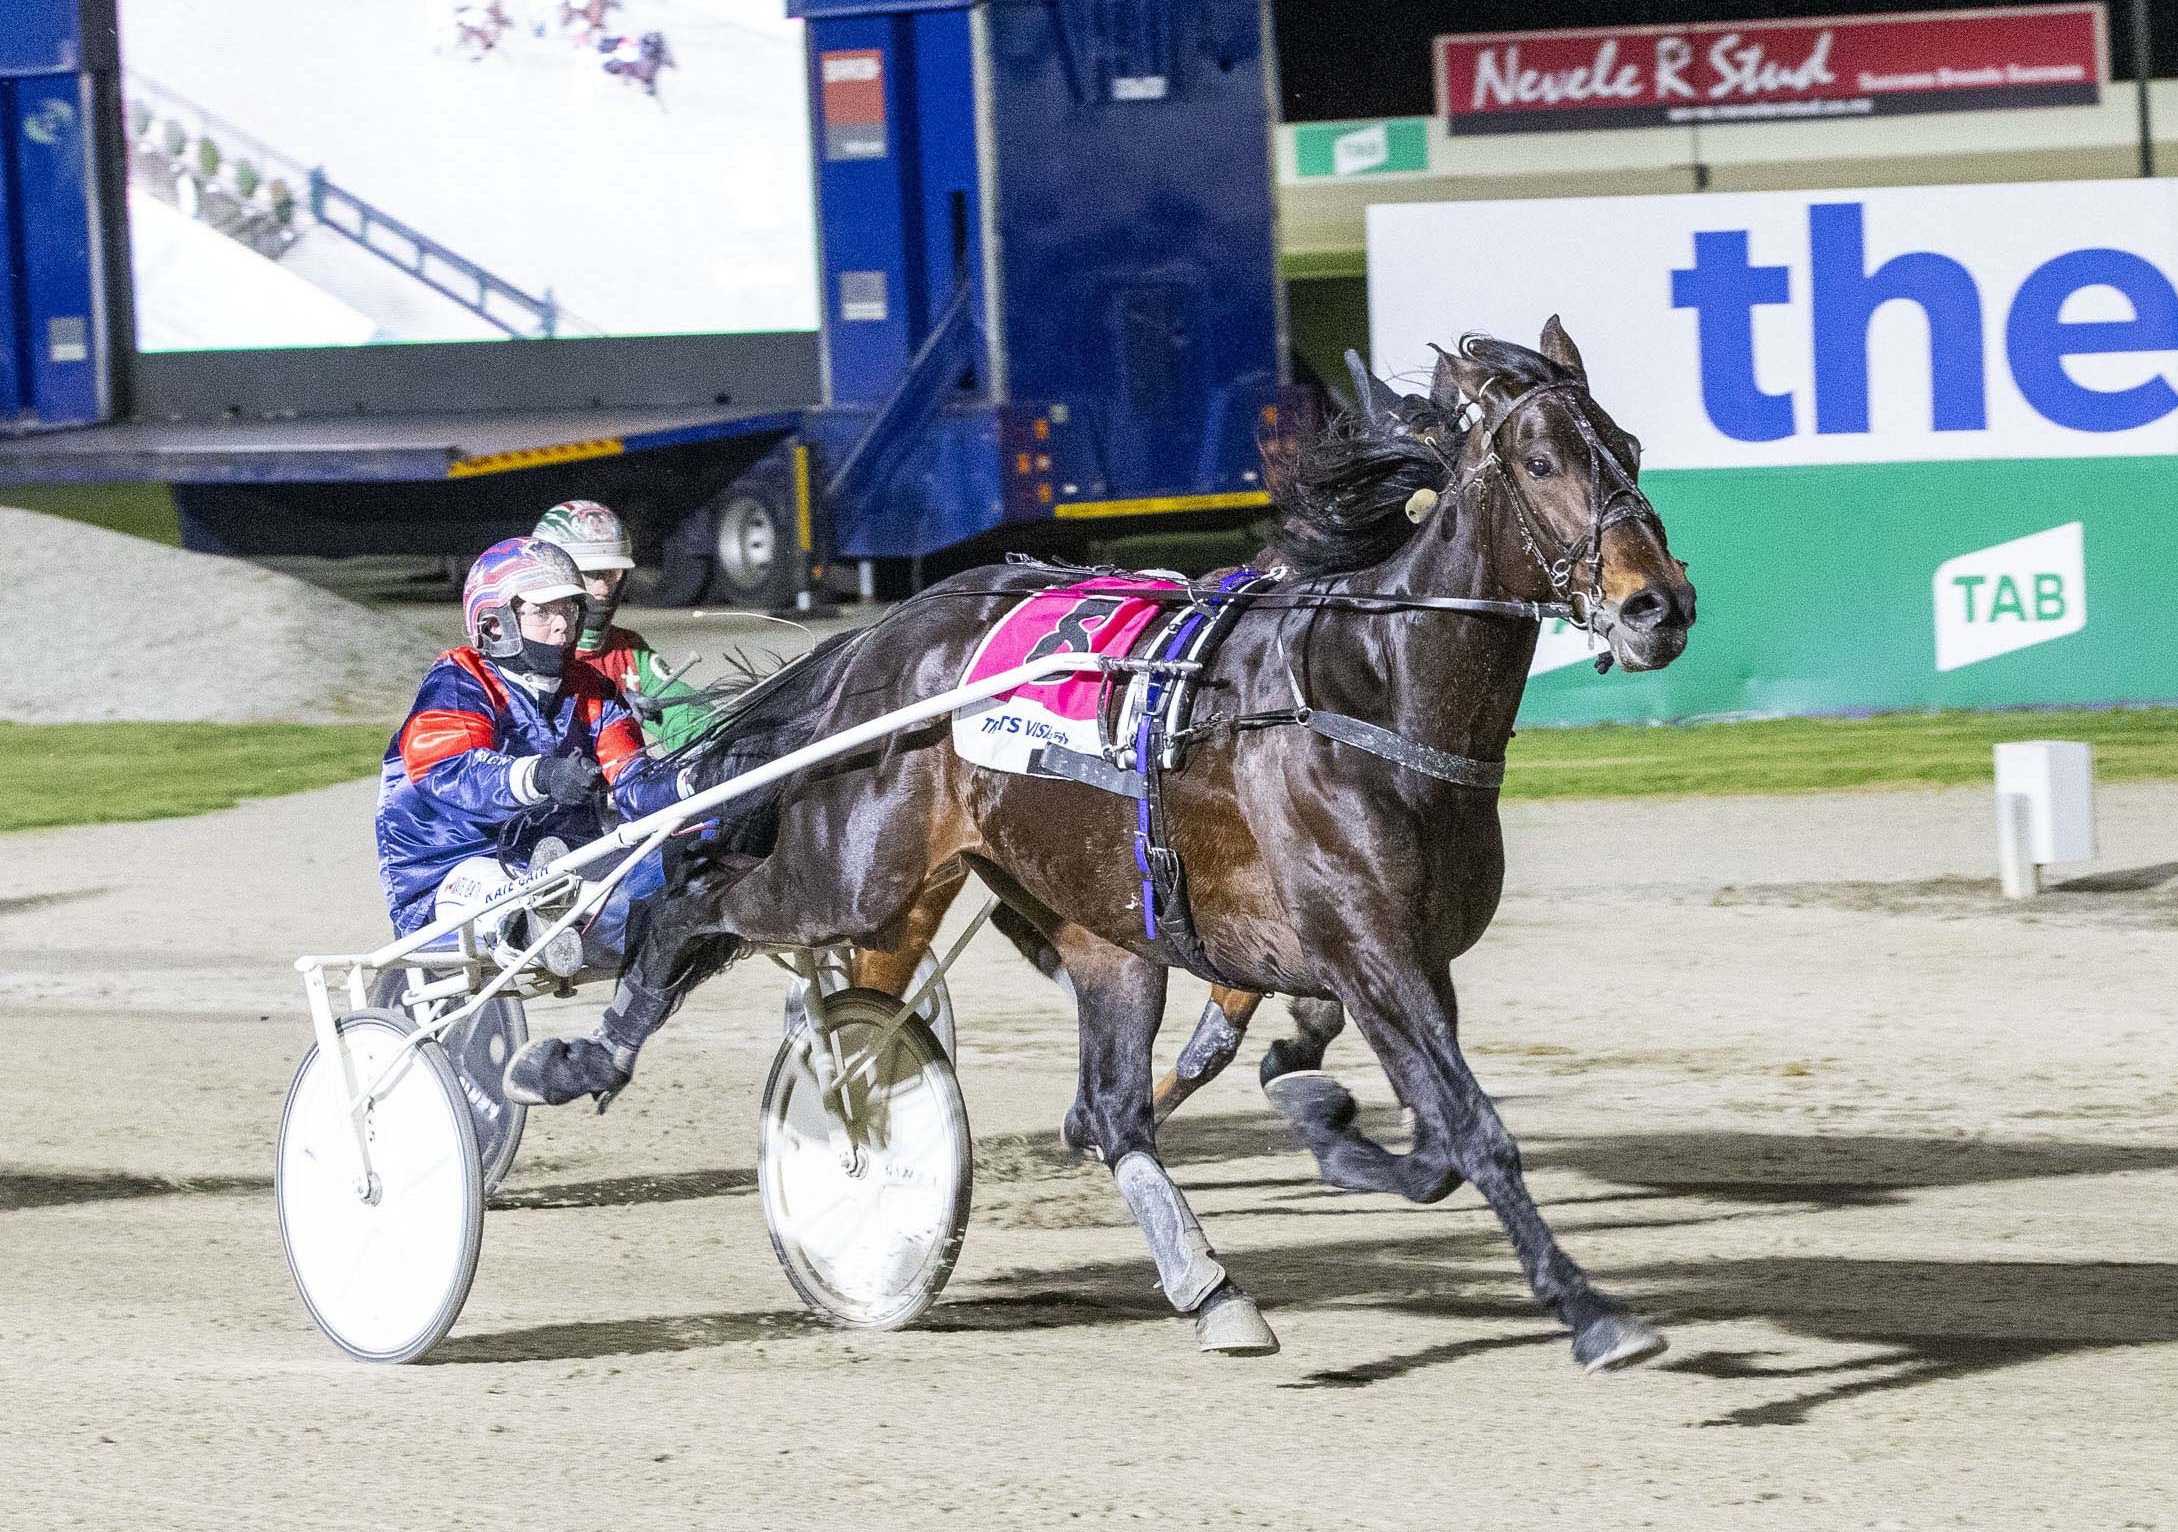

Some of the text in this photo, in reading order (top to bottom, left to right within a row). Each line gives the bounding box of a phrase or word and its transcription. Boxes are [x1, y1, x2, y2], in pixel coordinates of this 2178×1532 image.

[1471, 39, 1645, 109] Nevele
[1652, 35, 1696, 98] R
[1709, 31, 1836, 98] Stud
[1671, 203, 2178, 442] the
[1952, 573, 2066, 623] TAB
